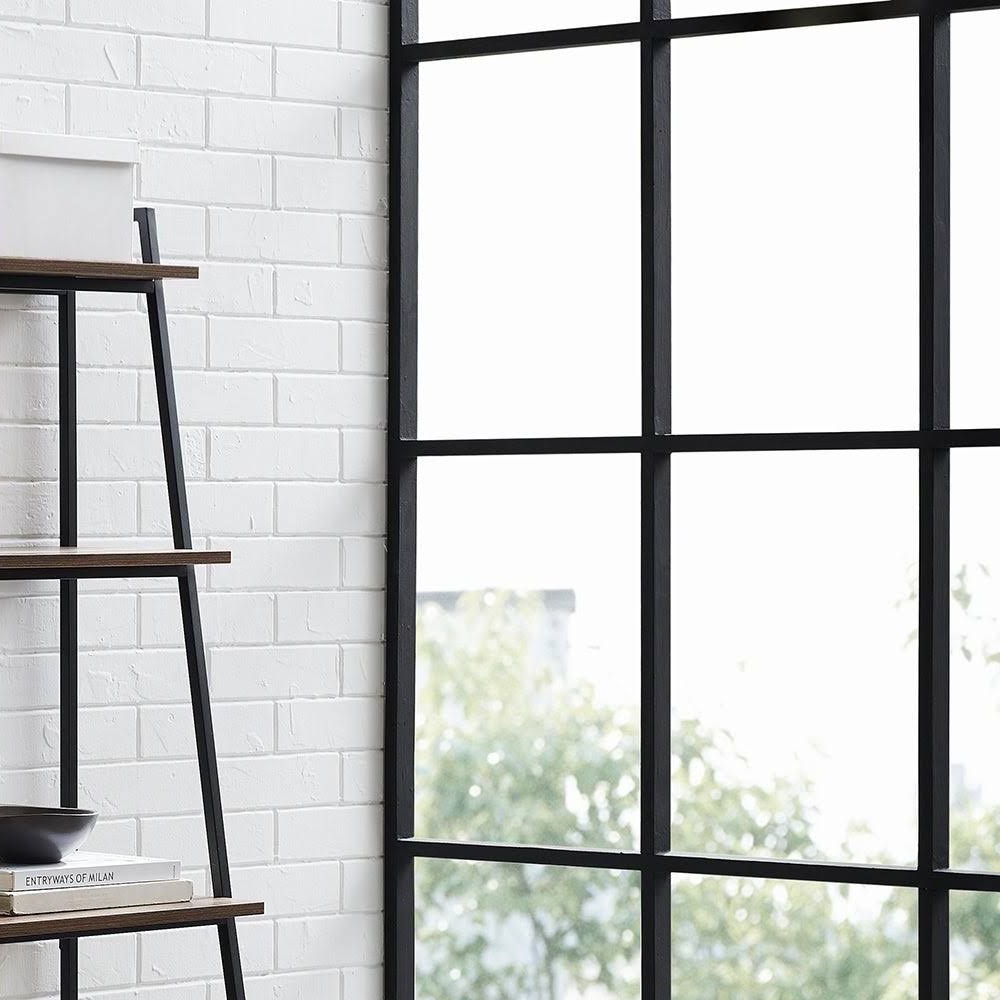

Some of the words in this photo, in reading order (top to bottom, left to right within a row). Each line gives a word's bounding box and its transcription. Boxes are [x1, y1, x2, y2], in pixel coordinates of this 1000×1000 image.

[25, 873, 74, 887] ENTRYWAYS
[76, 873, 87, 883] OF
[88, 871, 114, 882] MILAN
